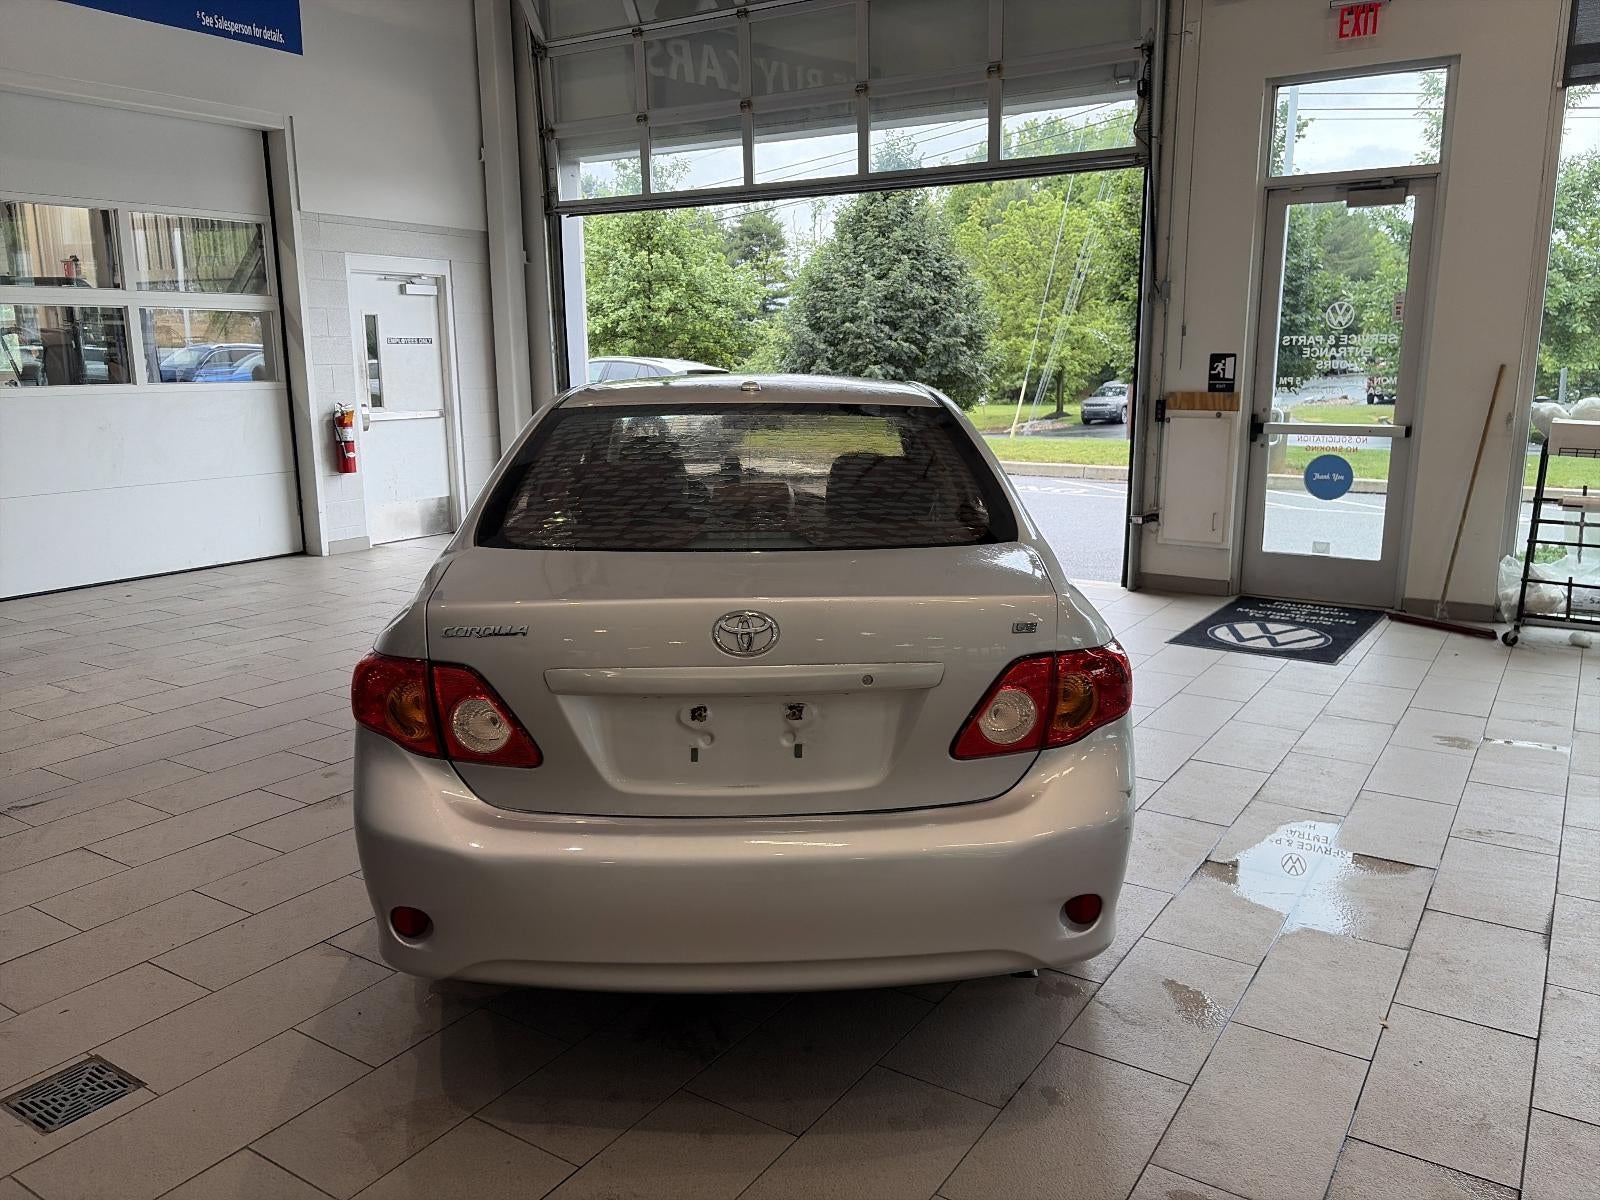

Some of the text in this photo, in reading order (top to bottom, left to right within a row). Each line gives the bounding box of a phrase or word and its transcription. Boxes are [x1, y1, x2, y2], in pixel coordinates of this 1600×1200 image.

[214, 14, 252, 35] Salesperson
[253, 23, 262, 38] for
[263, 26, 285, 43] details.
[1339, 2, 1381, 38] EXIT
[1313, 473, 1345, 482] Thank You
[441, 625, 529, 638] COROLLA
